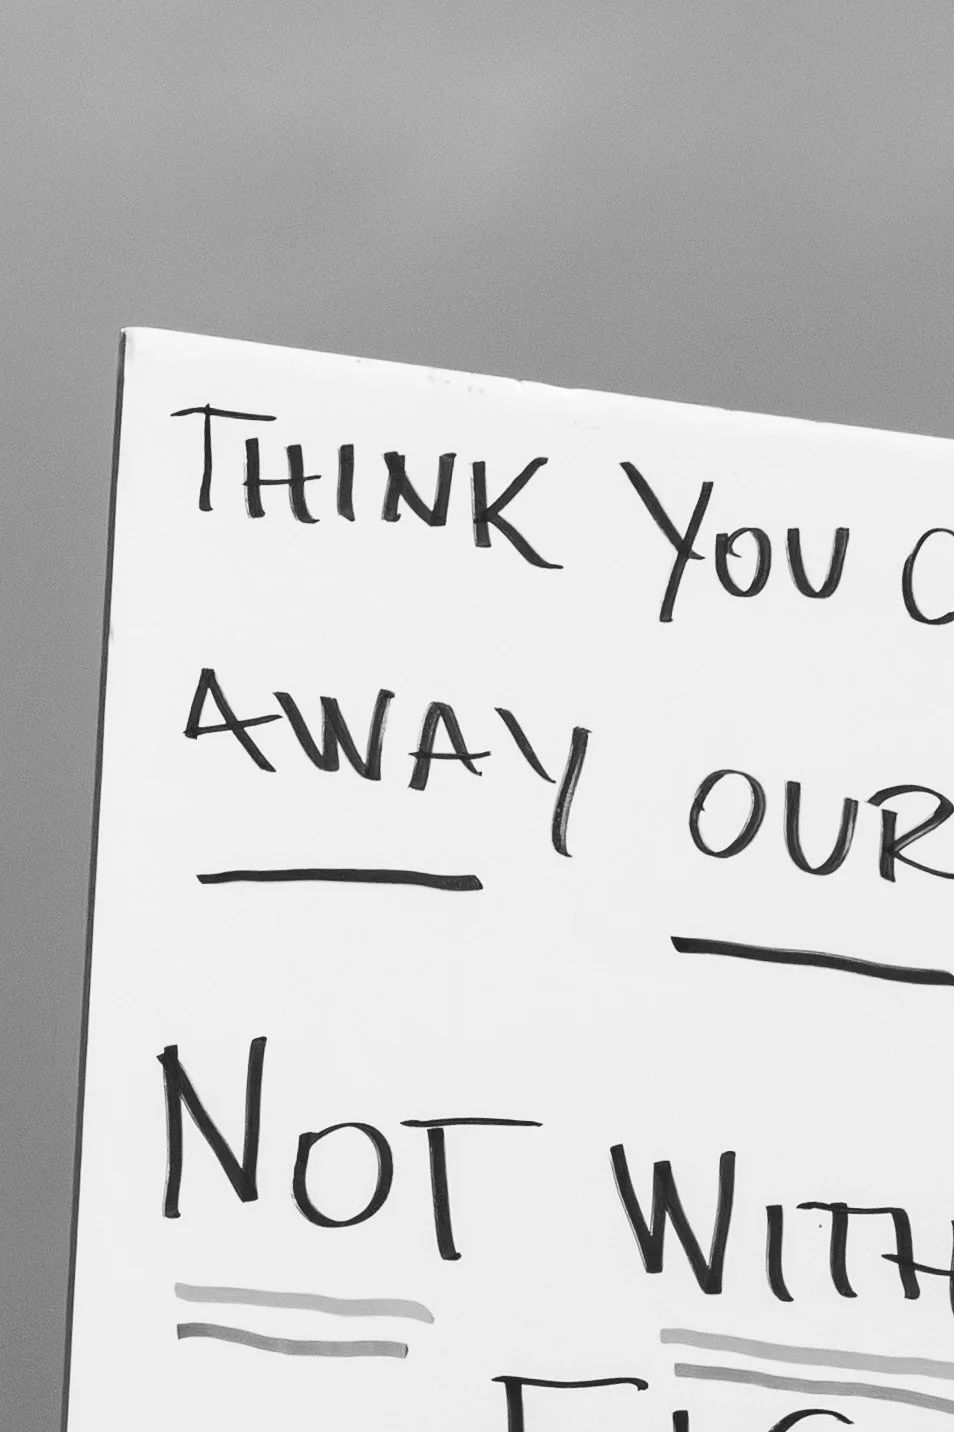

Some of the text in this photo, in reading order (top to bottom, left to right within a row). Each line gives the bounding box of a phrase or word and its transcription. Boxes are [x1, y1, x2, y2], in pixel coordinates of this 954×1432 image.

[169, 402, 565, 570] THINK
[618, 461, 850, 624] YOU
[182, 667, 593, 859] AWAY
[155, 1035, 544, 1262] NOT
